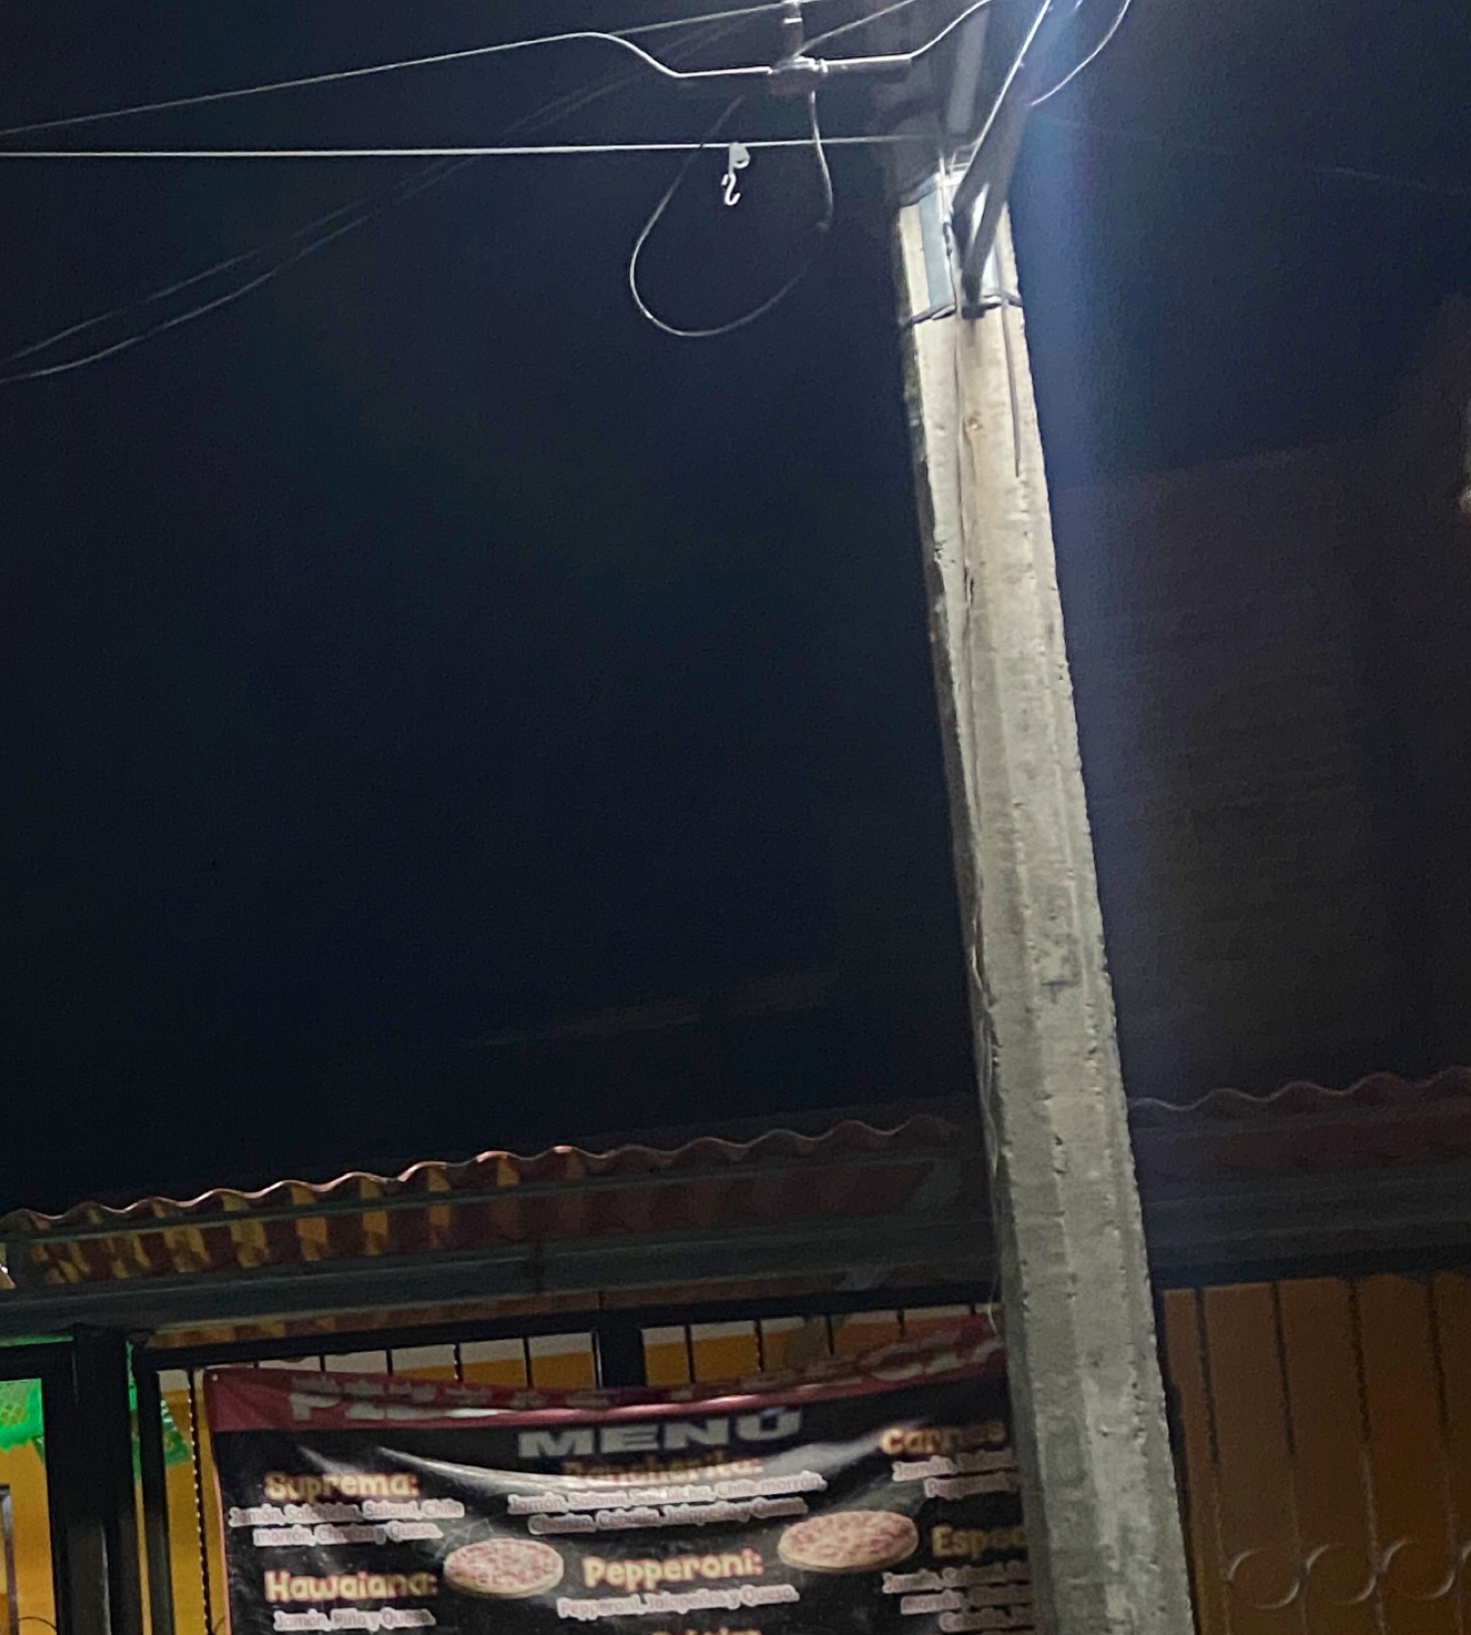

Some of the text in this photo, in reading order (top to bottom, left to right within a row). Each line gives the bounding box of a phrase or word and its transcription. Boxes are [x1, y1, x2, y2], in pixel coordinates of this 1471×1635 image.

[265, 1473, 420, 1503] Suprema:
[582, 1548, 763, 1592] Pepperoni:
[264, 1571, 438, 1602] Hawaiana:
